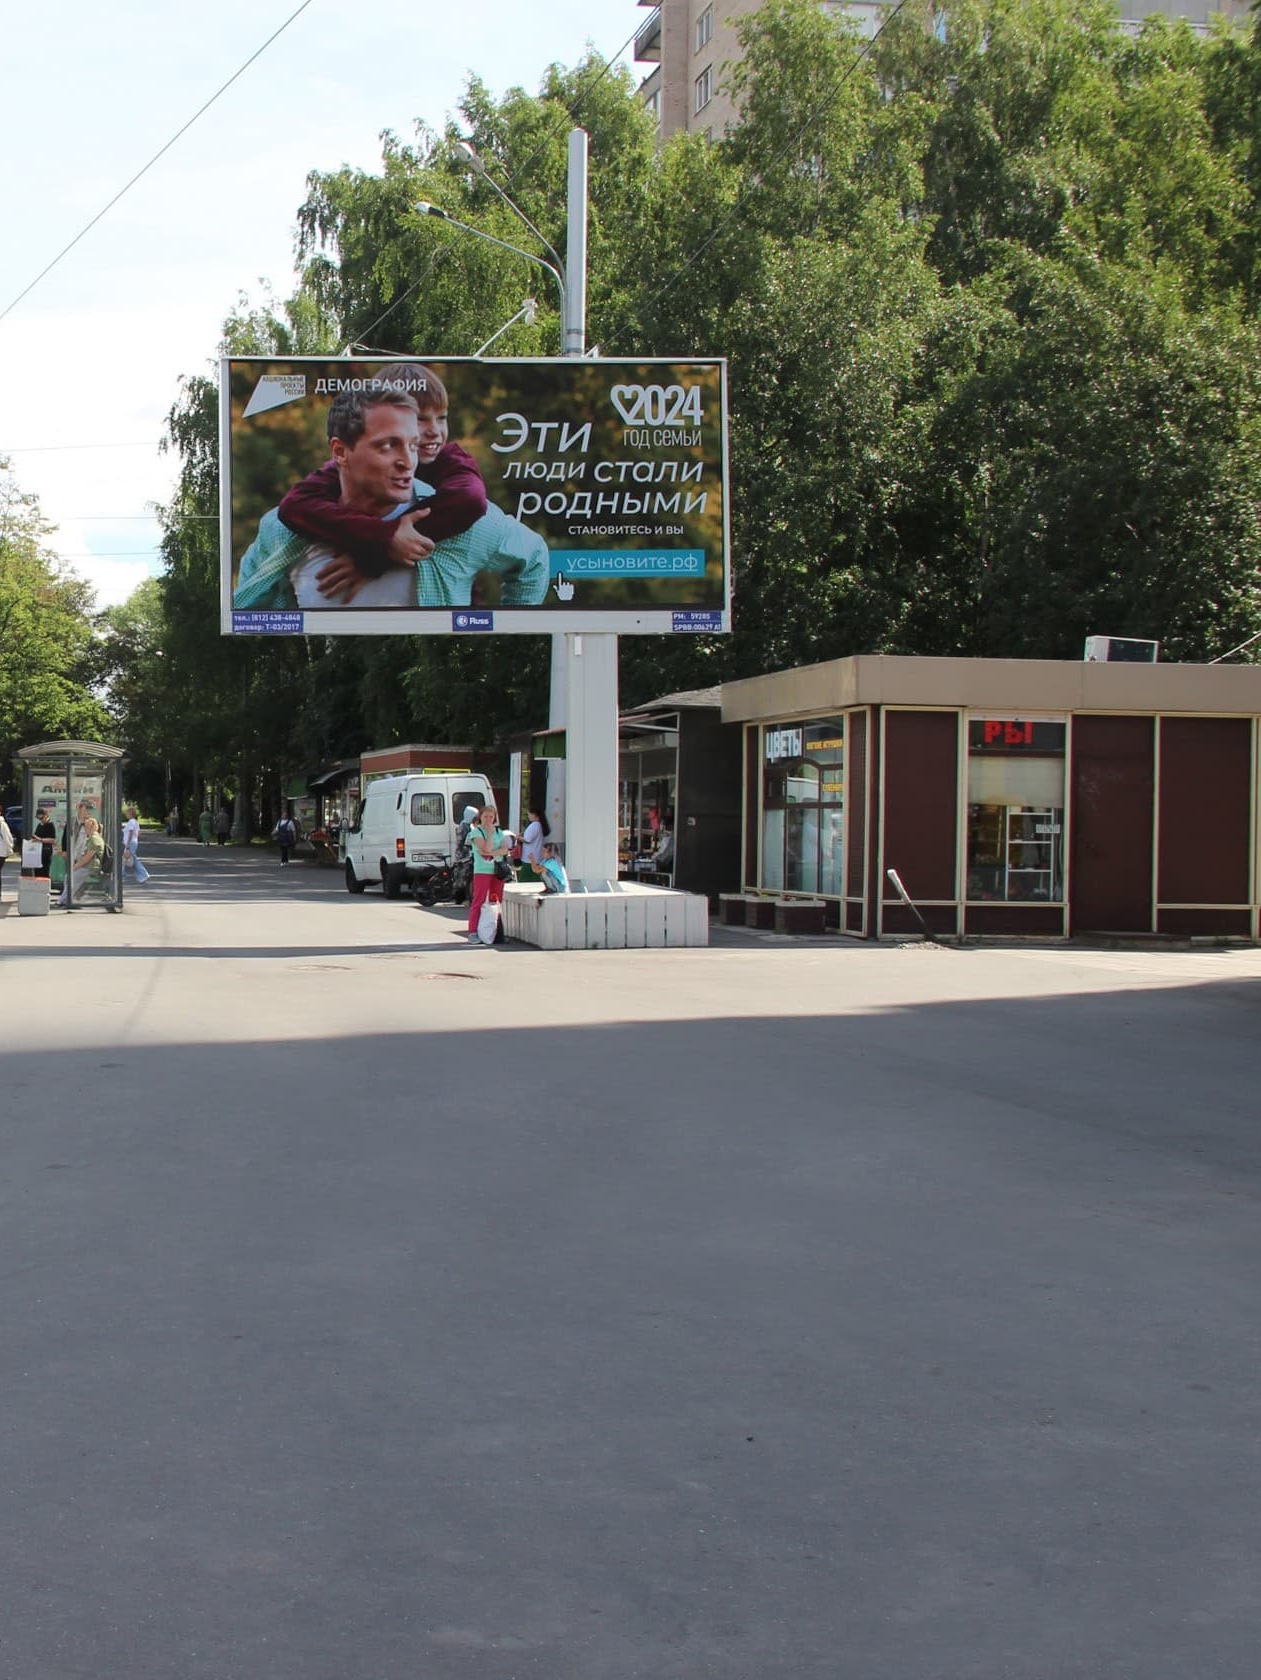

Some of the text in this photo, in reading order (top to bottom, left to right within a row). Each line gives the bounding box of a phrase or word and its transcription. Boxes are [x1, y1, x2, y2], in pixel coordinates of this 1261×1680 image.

[315, 378, 427, 394] ДЕМОГРАФИЯ
[611, 385, 704, 426] 2024
[490, 412, 592, 453] Эти
[502, 461, 704, 483] люди стали
[516, 491, 708, 522] родными
[568, 525, 684, 535] СТАНОВИТЕСЬ И ВЫ
[566, 553, 698, 572] усыновите.рф
[469, 617, 489, 625] Russ
[984, 720, 1034, 745] РЫ
[766, 728, 803, 763] ЦВЕТЫ
